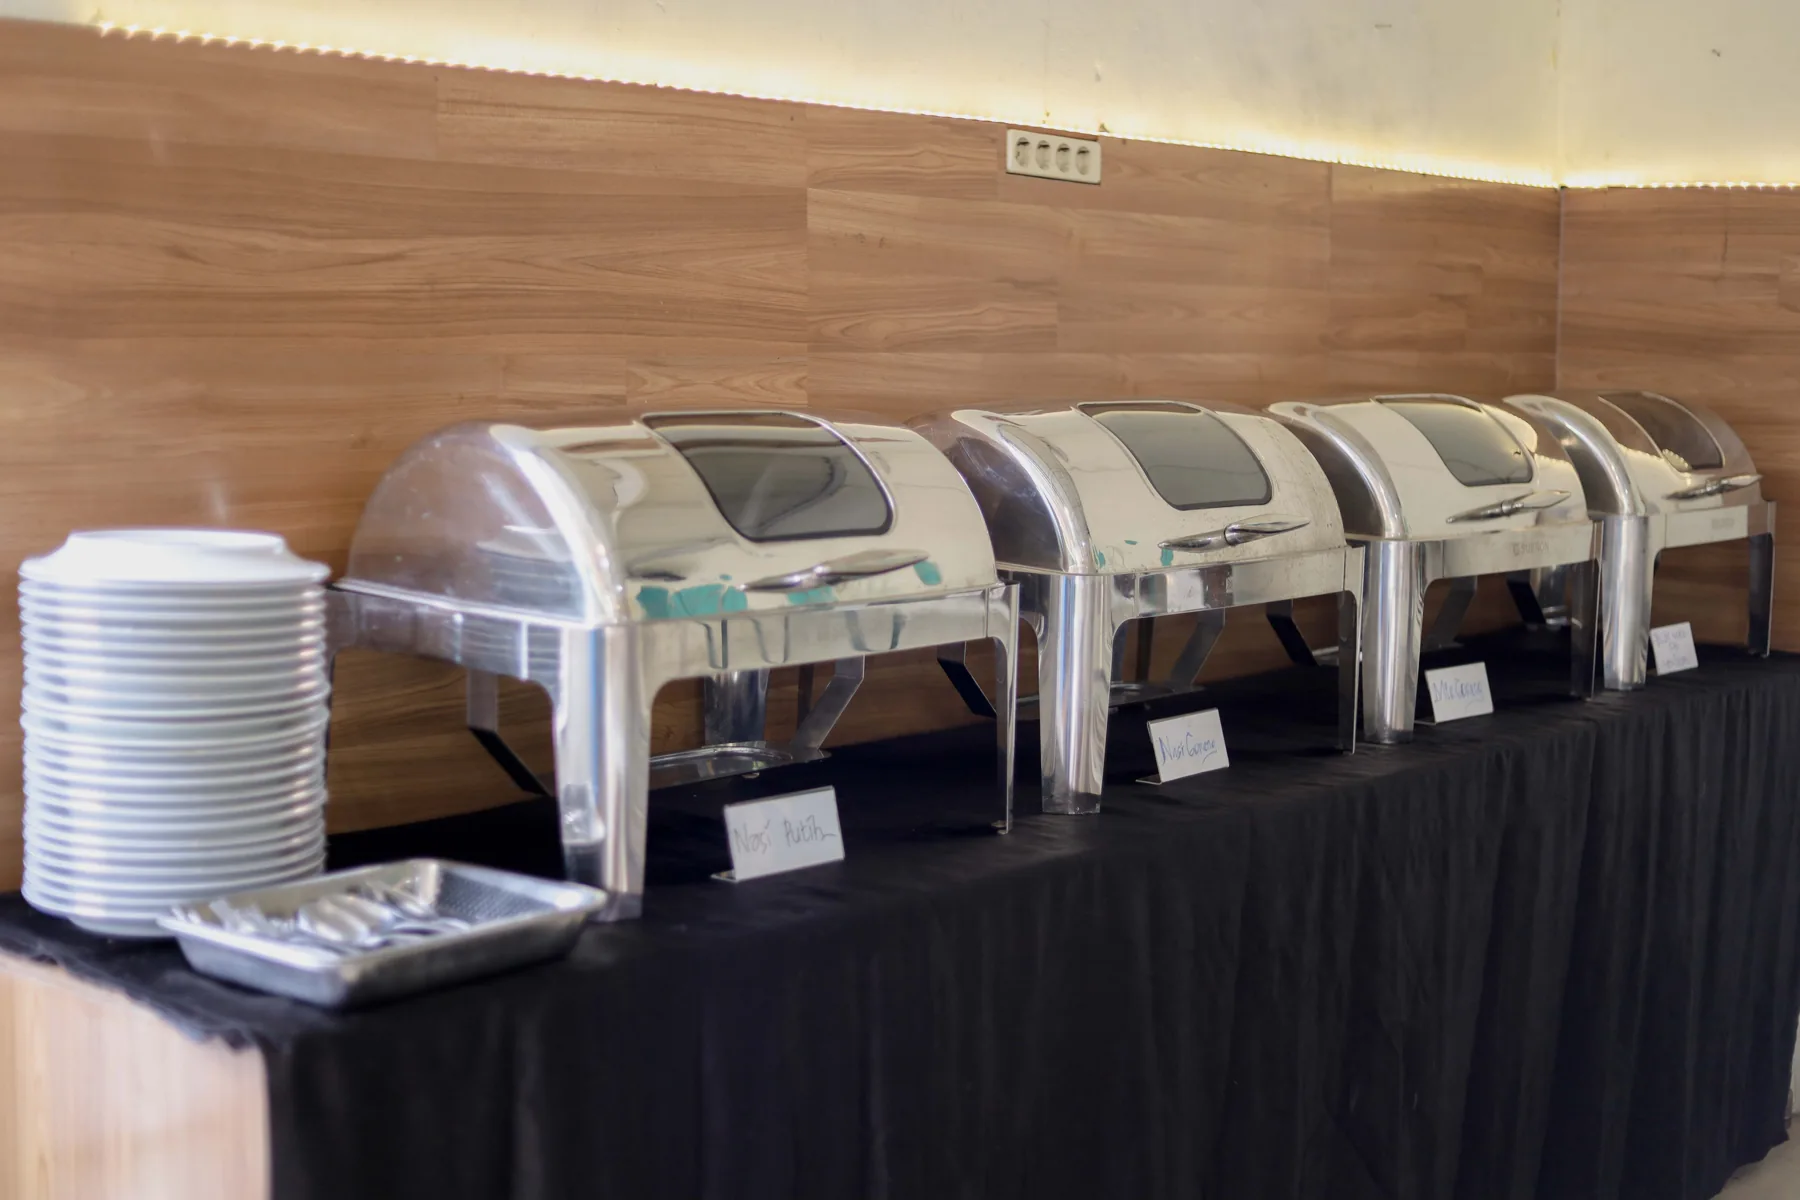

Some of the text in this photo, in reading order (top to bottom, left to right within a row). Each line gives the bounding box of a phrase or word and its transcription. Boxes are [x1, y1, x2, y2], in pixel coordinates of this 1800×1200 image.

[1158, 735, 1184, 766] Nasi
[733, 814, 837, 855] Nasi Putih
